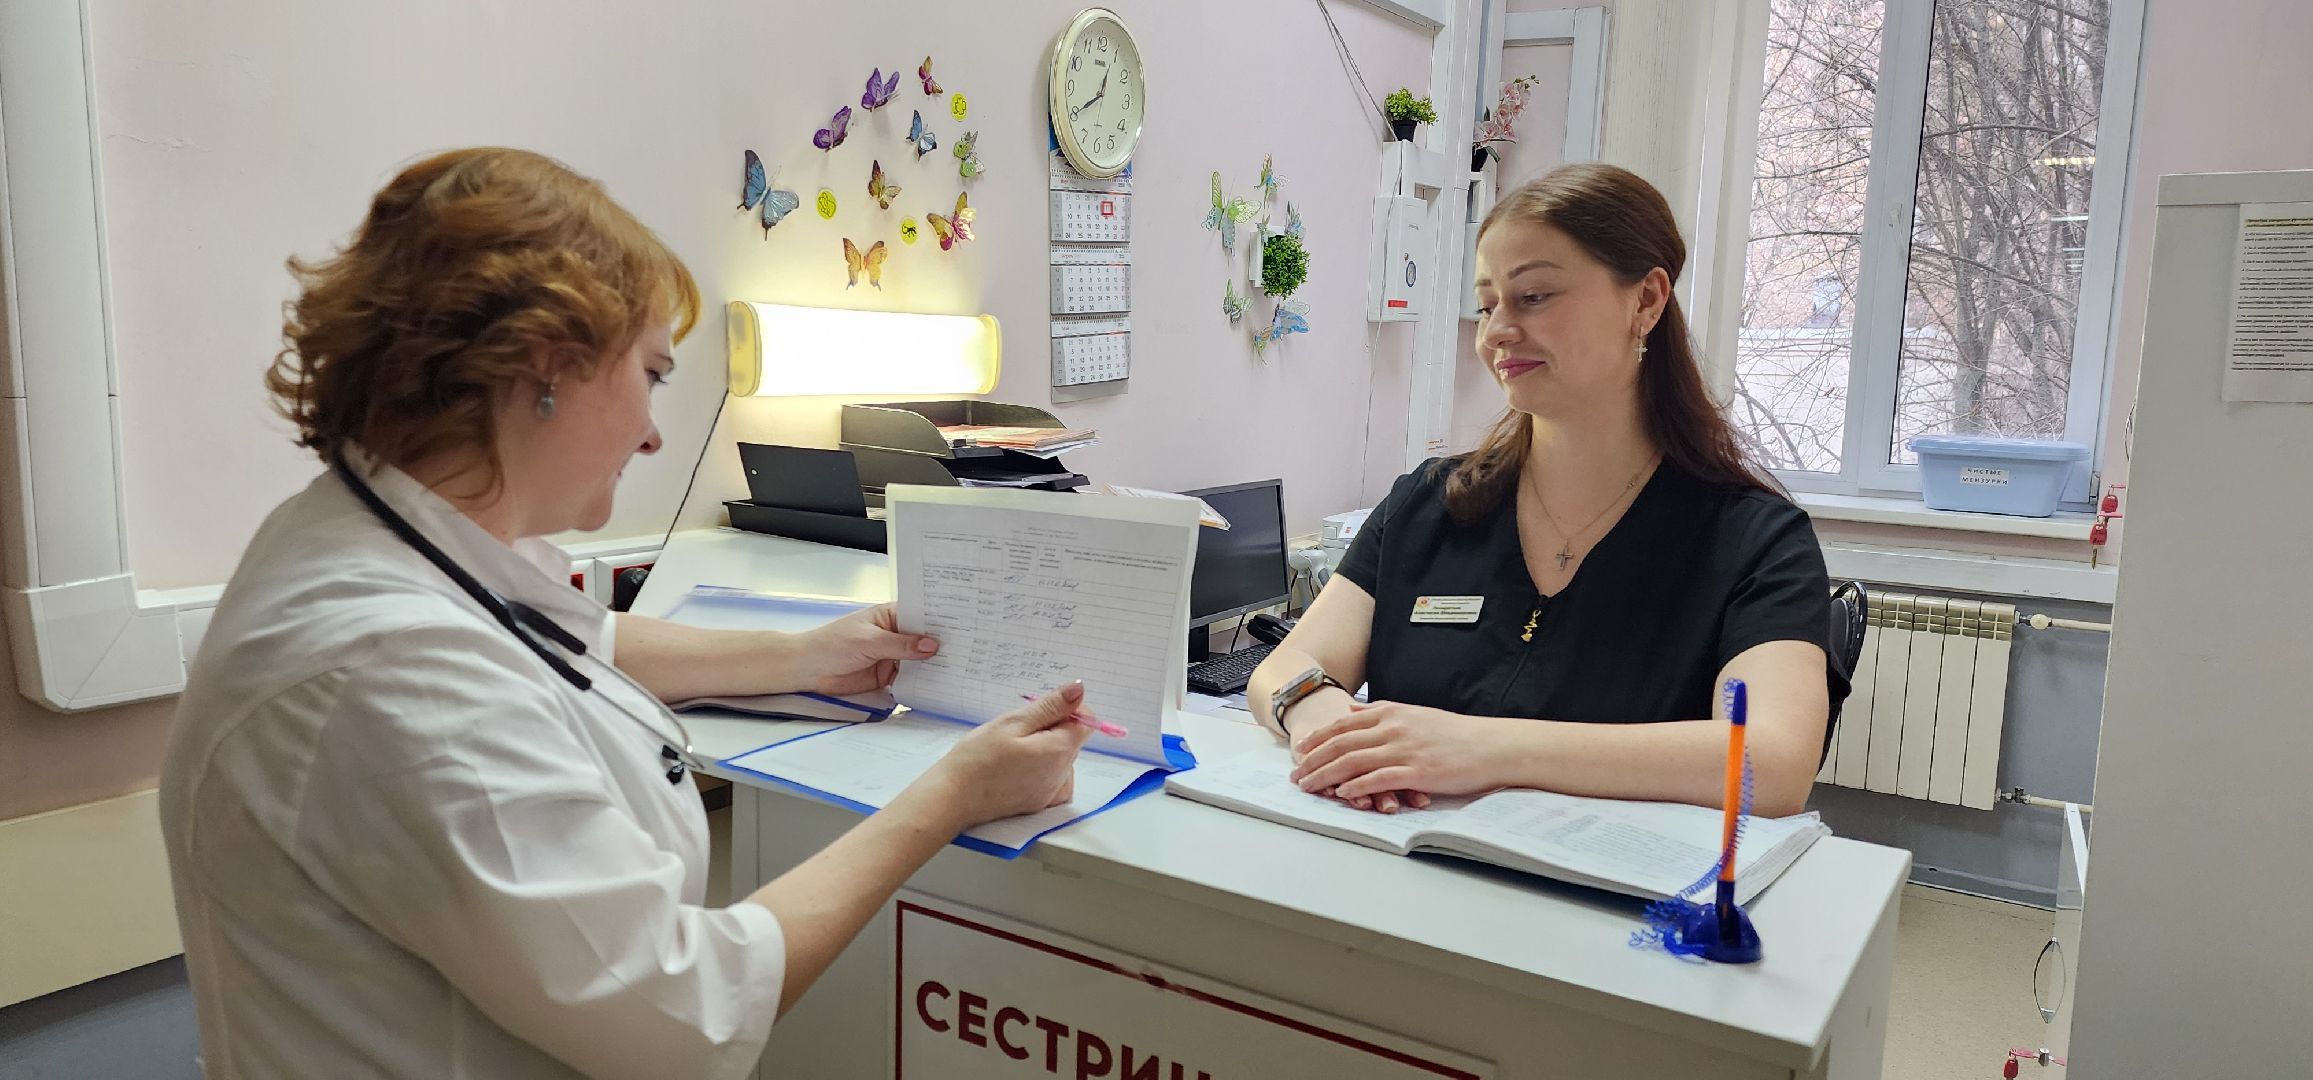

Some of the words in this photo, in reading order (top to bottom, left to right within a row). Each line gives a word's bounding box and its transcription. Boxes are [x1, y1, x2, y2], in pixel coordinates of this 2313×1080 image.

[1083, 38, 1092, 54] 11
[1097, 36, 1107, 52] 12
[1113, 45, 1120, 63] 1
[1072, 55, 1082, 71] 10
[1120, 69, 1128, 84] 2
[1067, 80, 1074, 97] 9
[1121, 93, 1130, 110] 3
[1070, 106, 1080, 121] 8
[1117, 119, 1126, 131] 4
[1081, 128, 1088, 143] 7
[1107, 135, 1115, 149] 5
[1094, 137, 1101, 153] 6
[1962, 477, 2008, 485] МЕНЗУРКИ
